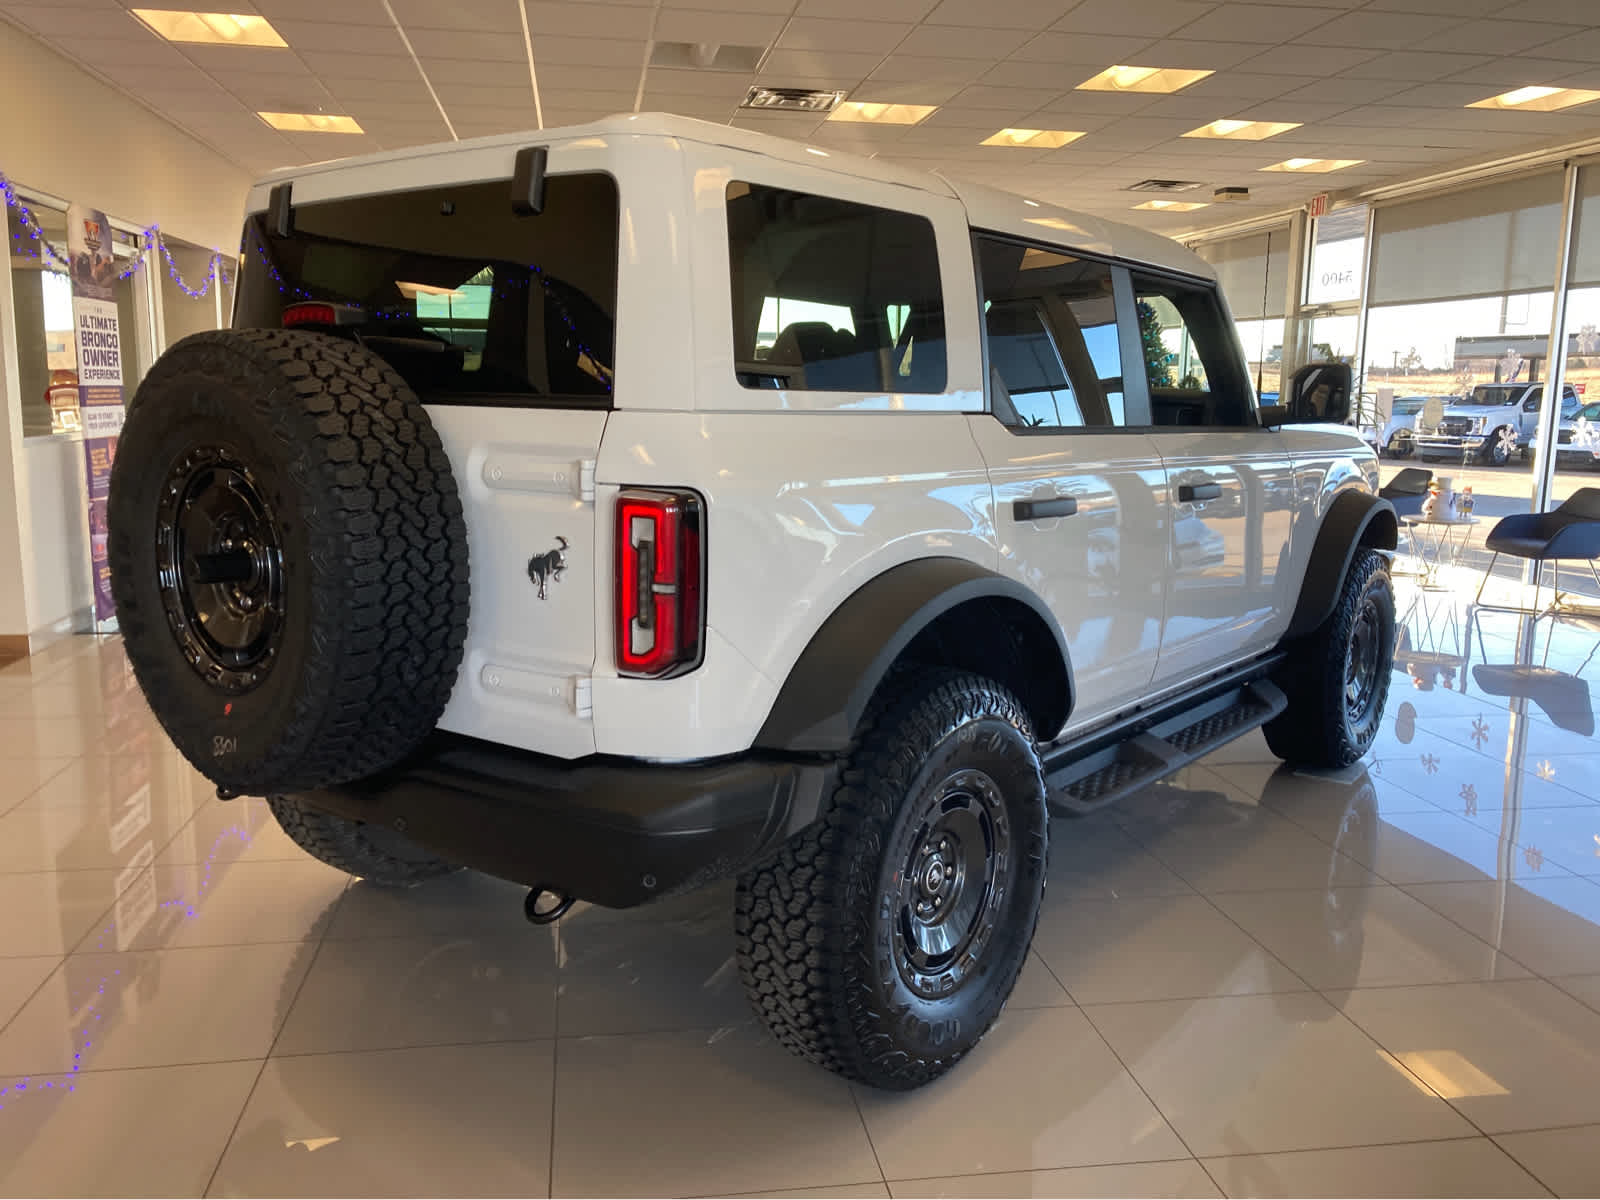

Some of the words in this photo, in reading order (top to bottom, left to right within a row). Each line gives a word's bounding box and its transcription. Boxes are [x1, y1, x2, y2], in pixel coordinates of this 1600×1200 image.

[1311, 195, 1326, 216] EXIT
[80, 315, 117, 332] ULTIMATE
[81, 330, 119, 349] BRONCO
[83, 348, 119, 368] OWNER
[84, 368, 121, 380] EXPERIENCE
